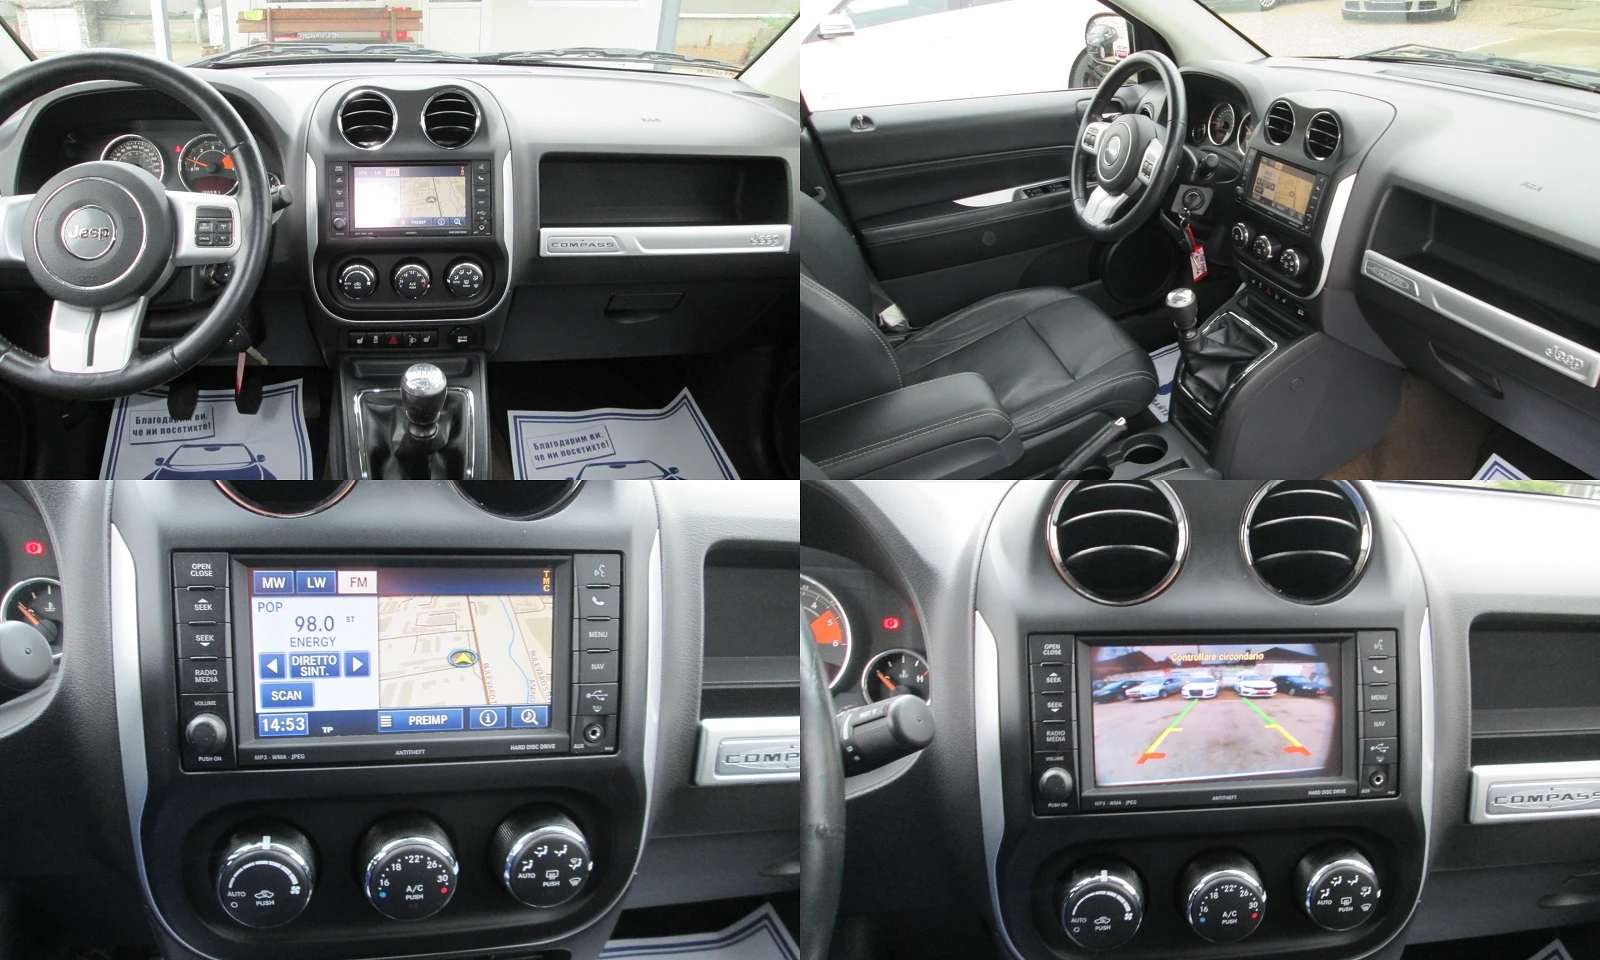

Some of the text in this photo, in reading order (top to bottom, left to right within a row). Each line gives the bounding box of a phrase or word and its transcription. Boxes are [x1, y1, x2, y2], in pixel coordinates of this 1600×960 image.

[67, 224, 110, 241] Jeep
[1545, 345, 1584, 370] Jeep
[132, 422, 211, 437] че ни посетихте!
[533, 434, 588, 451] Благодарим
[534, 440, 610, 461] че ни посетихте!
[262, 577, 286, 589] MW
[307, 577, 327, 589] LW
[350, 576, 368, 588] FM
[257, 602, 283, 613] POP
[295, 615, 335, 632] 98.0
[826, 618, 833, 627] 5
[588, 631, 608, 639] MENU
[290, 637, 336, 648] ENERGY
[832, 639, 839, 647] 6
[291, 655, 338, 667] DIRETTO
[1171, 652, 1264, 661] Controllare circondario
[194, 669, 218, 677] RADIO
[300, 666, 330, 677] SINT.
[916, 675, 924, 683] H
[271, 690, 302, 701] SCAN
[262, 717, 305, 733] 14:53
[408, 715, 448, 726] PREIMP
[322, 726, 334, 734] TP
[408, 855, 420, 863] 22
[391, 863, 402, 871] 18
[426, 861, 438, 869] 26
[379, 879, 390, 887] 16
[437, 874, 449, 883] 30
[405, 884, 424, 893] A/C
[1224, 884, 1234, 892] 22
[1239, 889, 1249, 897] 26
[1248, 901, 1258, 909] 30
[1222, 910, 1237, 918] A/C
